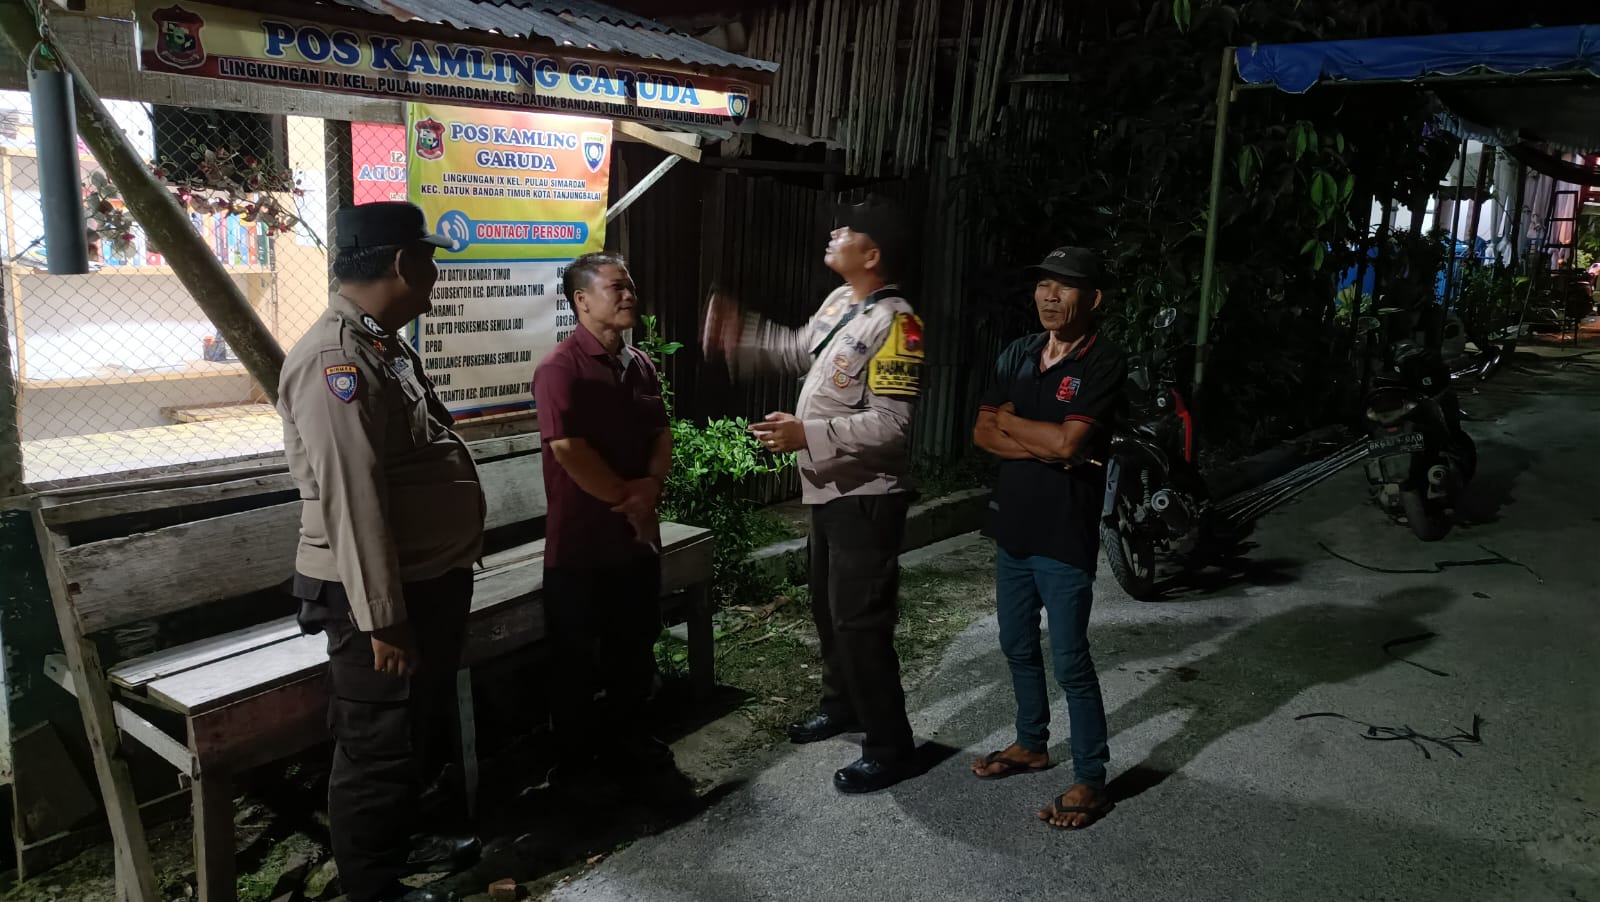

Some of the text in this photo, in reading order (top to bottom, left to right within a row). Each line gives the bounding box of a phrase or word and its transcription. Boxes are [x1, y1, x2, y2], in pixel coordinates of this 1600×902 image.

[263, 19, 701, 106] POS KAMLING GARUDA
[218, 58, 319, 85] LINGKUNGAN
[324, 71, 340, 87] IX
[343, 73, 373, 90] KEL.
[377, 77, 421, 94] PULAU
[424, 82, 489, 100] SIMARDAN
[522, 92, 558, 107] DATUK
[560, 96, 600, 112] BANDAR
[604, 101, 635, 116] TIMUR
[637, 106, 660, 118] KOTA
[662, 109, 723, 126] TANJUNGBALAI
[450, 123, 577, 149] POS KAMLING
[475, 150, 556, 170] GARUDA
[443, 172, 586, 189] LINGKUNGAN IX KEL. PULAU SIMARDAN
[421, 184, 601, 200] KEC. DATUK BANDAR TIMUR KOTA TANJUNGBALAI
[477, 223, 529, 239] CONTACT
[533, 223, 574, 239] PERSON
[447, 268, 468, 281] DATUK
[468, 268, 492, 281] BANDAR
[493, 267, 511, 281] TIMUR
[486, 285, 505, 298] DATUK
[505, 284, 527, 297] BANDAR
[528, 283, 545, 297] TIMUR
[458, 303, 464, 316] 17
[436, 321, 453, 335] UPTD
[453, 320, 489, 334] PUSKESMAS
[489, 318, 512, 332] SEMULA
[425, 340, 442, 353] BPBD
[425, 355, 462, 370] AMBULANCE
[462, 353, 497, 368] PUSKESMAS
[497, 351, 519, 365] SEMULA
[479, 385, 498, 399] DATUK
[498, 382, 520, 397] BANDAR
